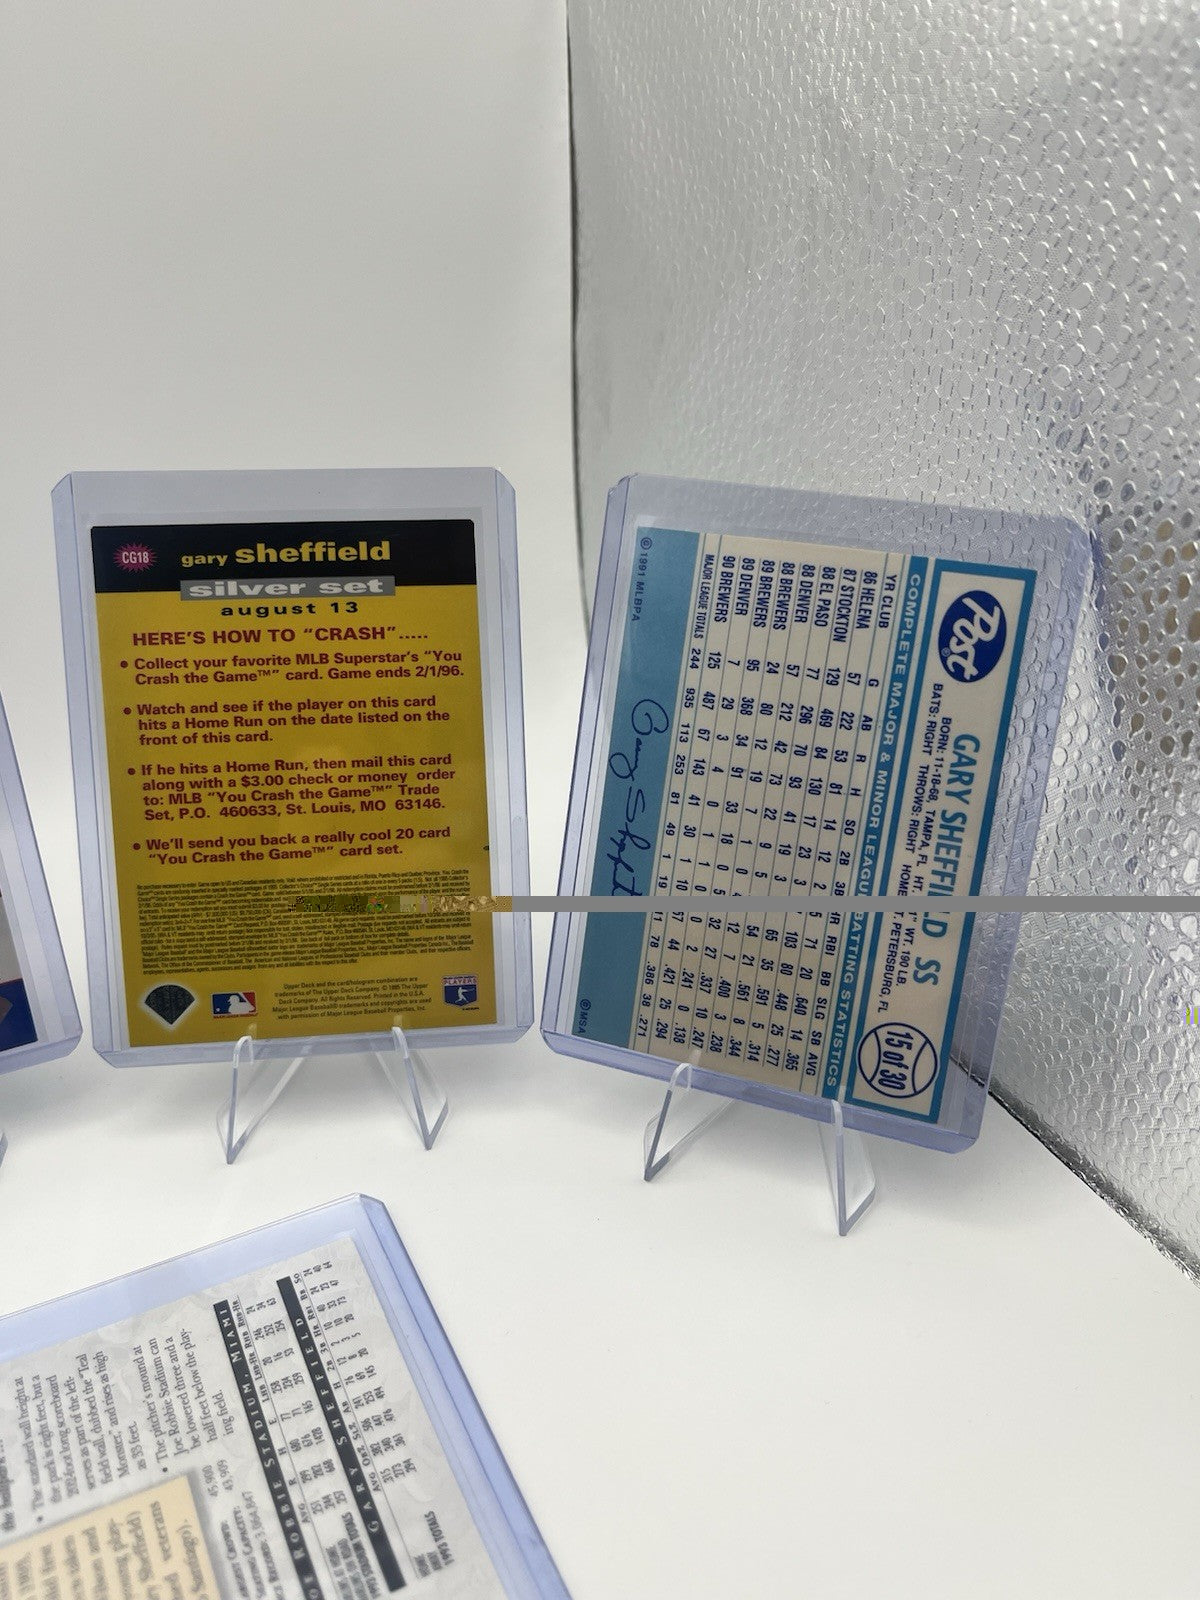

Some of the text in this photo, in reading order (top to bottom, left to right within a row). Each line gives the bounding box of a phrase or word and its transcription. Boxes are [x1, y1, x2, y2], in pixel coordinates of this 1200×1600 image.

[122, 551, 148, 563] CG18
[181, 540, 390, 567] gary sheffield
[189, 578, 383, 596] silver set
[220, 601, 358, 618] august 13
[132, 630, 206, 646] HERE'S
[212, 629, 261, 643] HOW
[266, 628, 295, 642] TO
[946, 596, 999, 680] Post
[134, 657, 188, 669] Collect
[192, 658, 227, 670] your
[231, 654, 291, 666] favorite
[295, 652, 329, 665] MLB
[333, 650, 419, 665] Superstar's
[134, 672, 179, 685] Crash
[183, 671, 208, 683] the
[285, 668, 323, 680] card.
[327, 667, 371, 679] Game
[375, 665, 411, 678] ends
[415, 664, 464, 678] 2/1/96.
[136, 694, 435, 715] Watch and see if the player on this card
[928, 683, 943, 717] BATS:
[138, 709, 450, 730] hits a Home Run on the date listed on the
[814, 570, 878, 890] 86 HELENA 57 222 53 81 14 12 2
[138, 729, 273, 745] front of this card.
[922, 720, 937, 755] RIGHT
[141, 752, 451, 776] If he hits a Home Run, then mail this card
[142, 768, 455, 792] along with a $3.00 check or money order
[142, 795, 163, 806] to:
[168, 792, 202, 805] MLB
[250, 788, 294, 801] Crash
[298, 787, 323, 799] the
[397, 783, 439, 795] Trade
[910, 764, 929, 816] THROWS:
[143, 797, 445, 821] Set, P.O. 460633, St. Louis, MO 63146.
[145, 826, 450, 850] We'll send you back a really cool 20 card
[826, 573, 920, 1086] COMPLETE MAJOR & MINOR LEAGU BATTING STATISTICS
[905, 818, 919, 853] RIGHT
[191, 850, 235, 863] Crash
[238, 849, 264, 861] the
[339, 843, 372, 856] card
[376, 844, 402, 854] set.
[895, 716, 952, 986] BORN: 11-18-68, TAMPA, FL HT. WT. 190 LB.
[912, 733, 980, 985] GARY SHEFFID SS
[897, 864, 911, 896] HOME
[878, 922, 902, 997] PETERSBURG,
[877, 1000, 888, 1013] FL
[876, 1030, 913, 1090] 15 of 30
[148, 1337, 189, 1456] Joe Robbie Stadium can
[163, 1335, 201, 1450] be lowered three and a
[180, 1328, 217, 1443] half feet below the play-
[132, 1344, 168, 1463] The pitcher's mound at
[211, 1389, 234, 1436] ing field.
